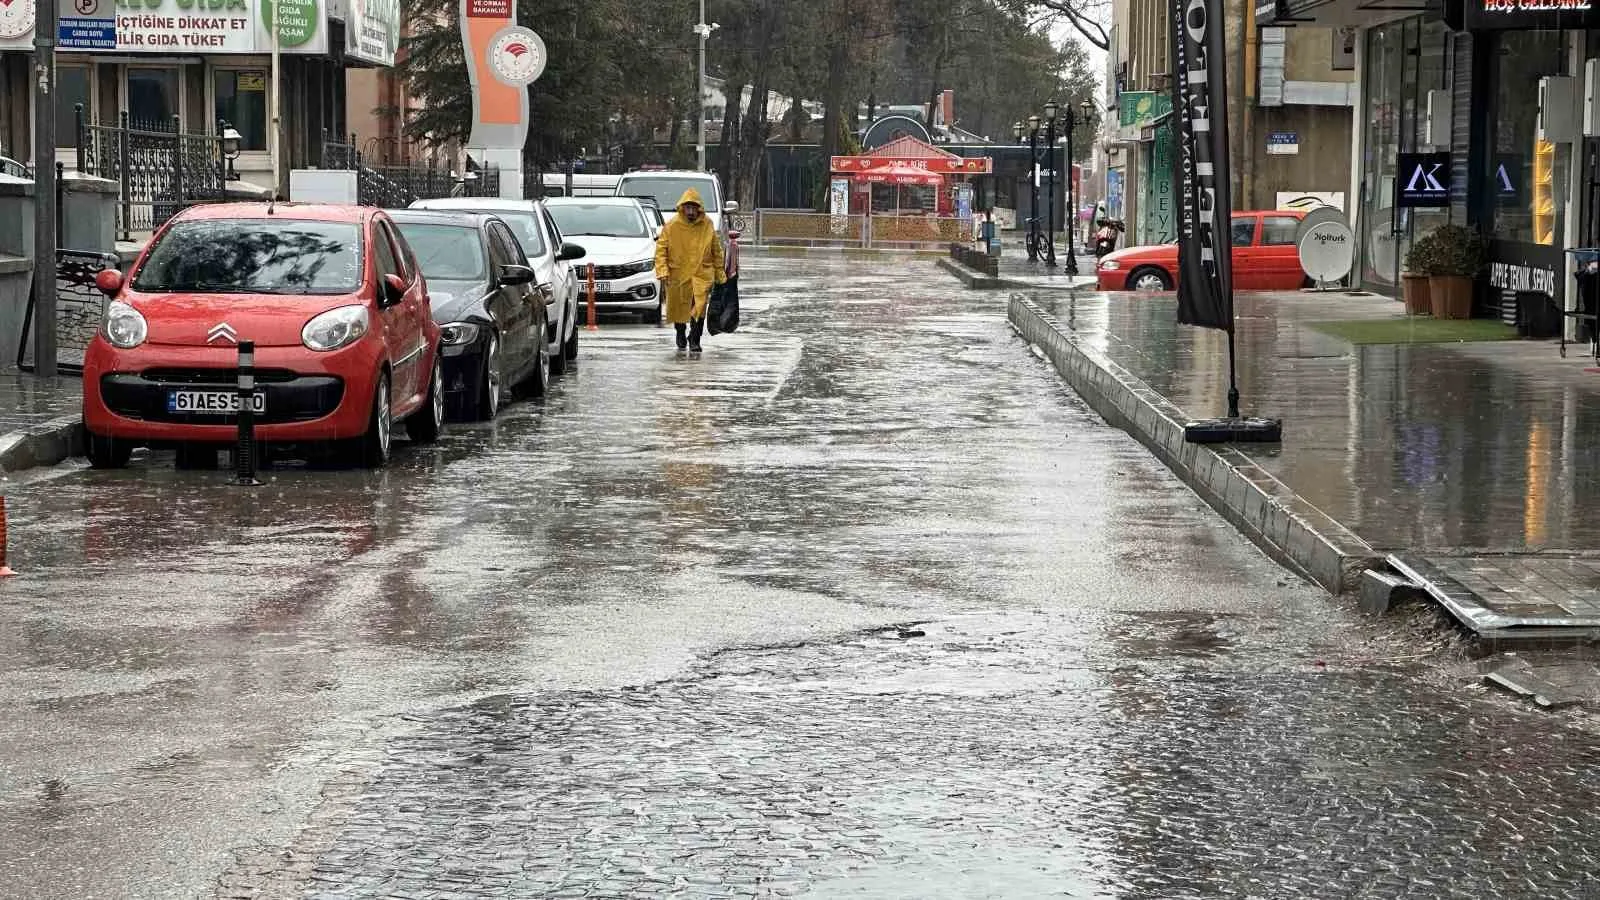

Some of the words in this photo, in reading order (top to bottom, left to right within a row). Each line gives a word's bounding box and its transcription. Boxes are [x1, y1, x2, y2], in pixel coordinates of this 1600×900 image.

[279, 6, 301, 14] GIDA
[116, 14, 175, 30] İÇTİĞİNE
[179, 15, 226, 29] DİKKAT
[230, 18, 247, 30] ET
[115, 31, 144, 45] İLİR
[147, 34, 180, 46] GIDA
[182, 32, 226, 46] TÜKET
[279, 27, 305, 37] AŞAM
[1403, 163, 1446, 191] AK
[1490, 262, 1508, 288] APPLE
[1509, 260, 1531, 291] TEKNİK
[1532, 264, 1555, 298] SERVİS
[177, 393, 264, 410] 61AES50
